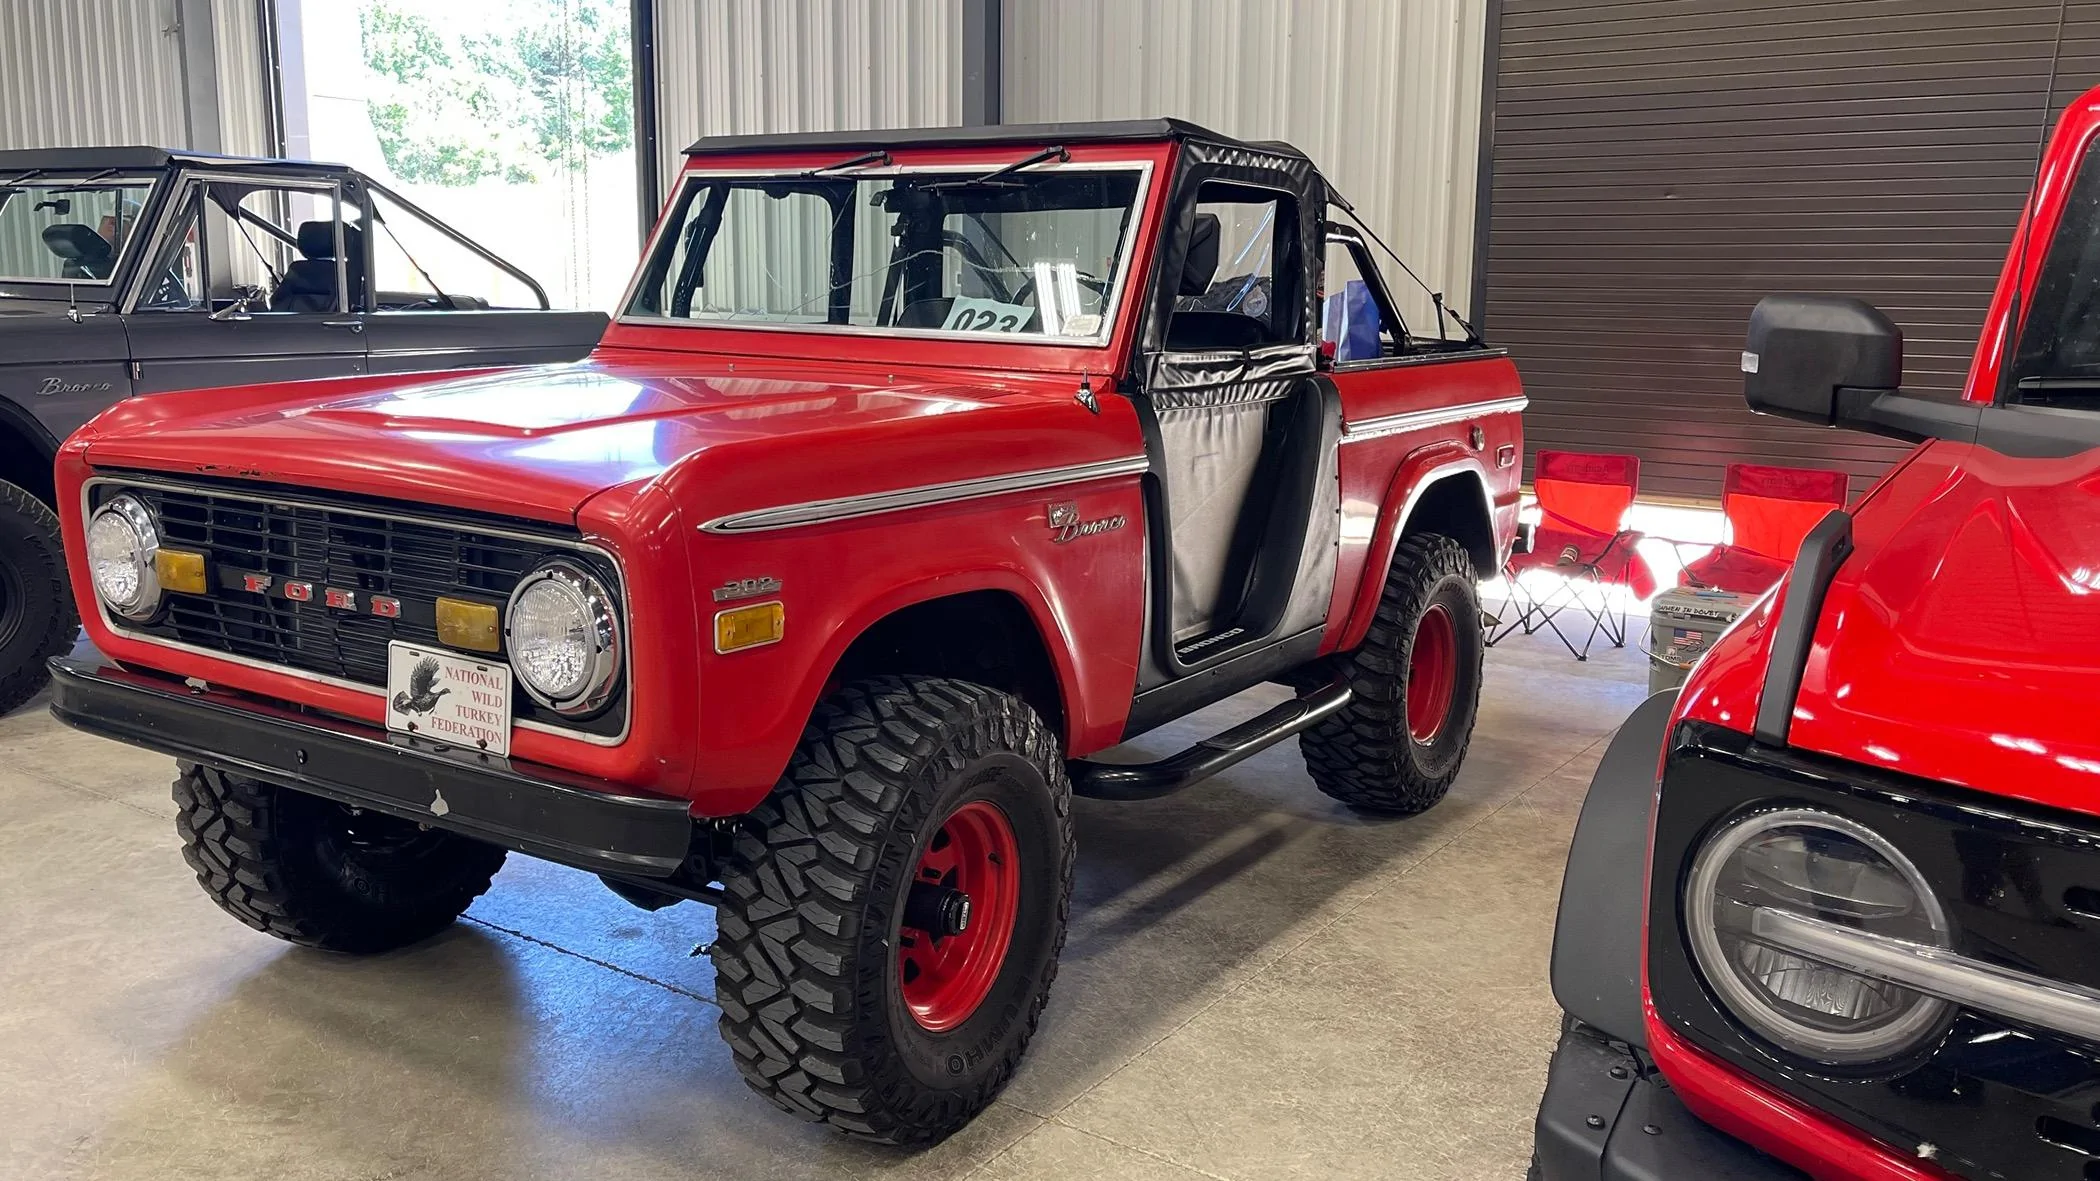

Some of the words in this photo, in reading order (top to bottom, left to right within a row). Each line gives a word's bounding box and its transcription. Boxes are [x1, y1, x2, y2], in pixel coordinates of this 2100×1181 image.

[951, 308, 1019, 332] 023
[1052, 512, 1128, 544] Bronco
[243, 573, 401, 619] FORD
[719, 576, 779, 599] 302
[444, 665, 503, 691] NATIONAL
[471, 690, 503, 709] WILD
[455, 704, 503, 727] TURKEY
[431, 717, 503, 745] FEDERATION
